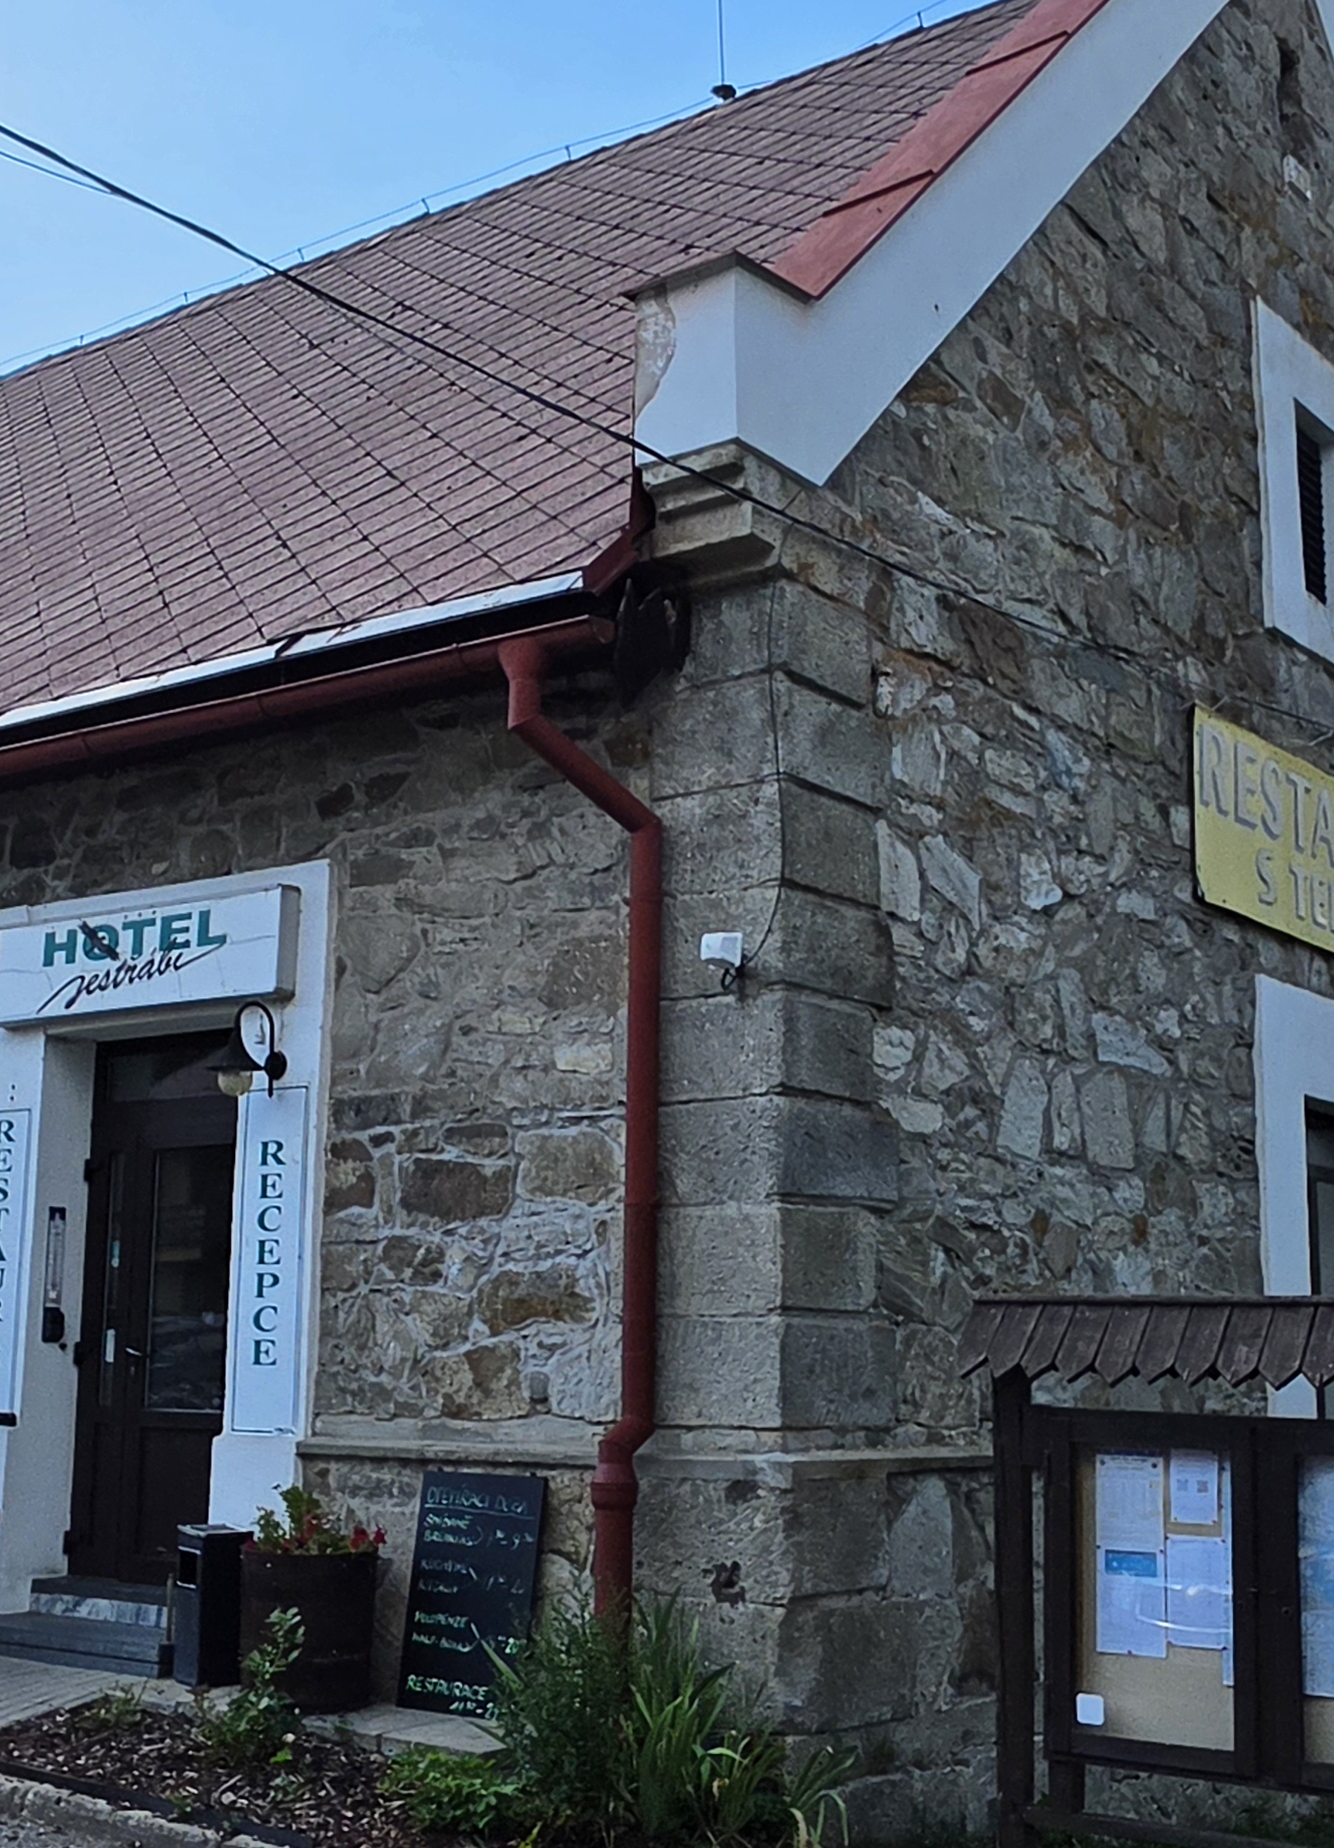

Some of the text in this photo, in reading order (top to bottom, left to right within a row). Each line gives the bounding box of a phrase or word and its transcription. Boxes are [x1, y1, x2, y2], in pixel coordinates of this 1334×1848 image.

[1255, 847, 1278, 907] S
[41, 909, 228, 968] HOTEL
[250, 1138, 287, 1368] RECEPCE
